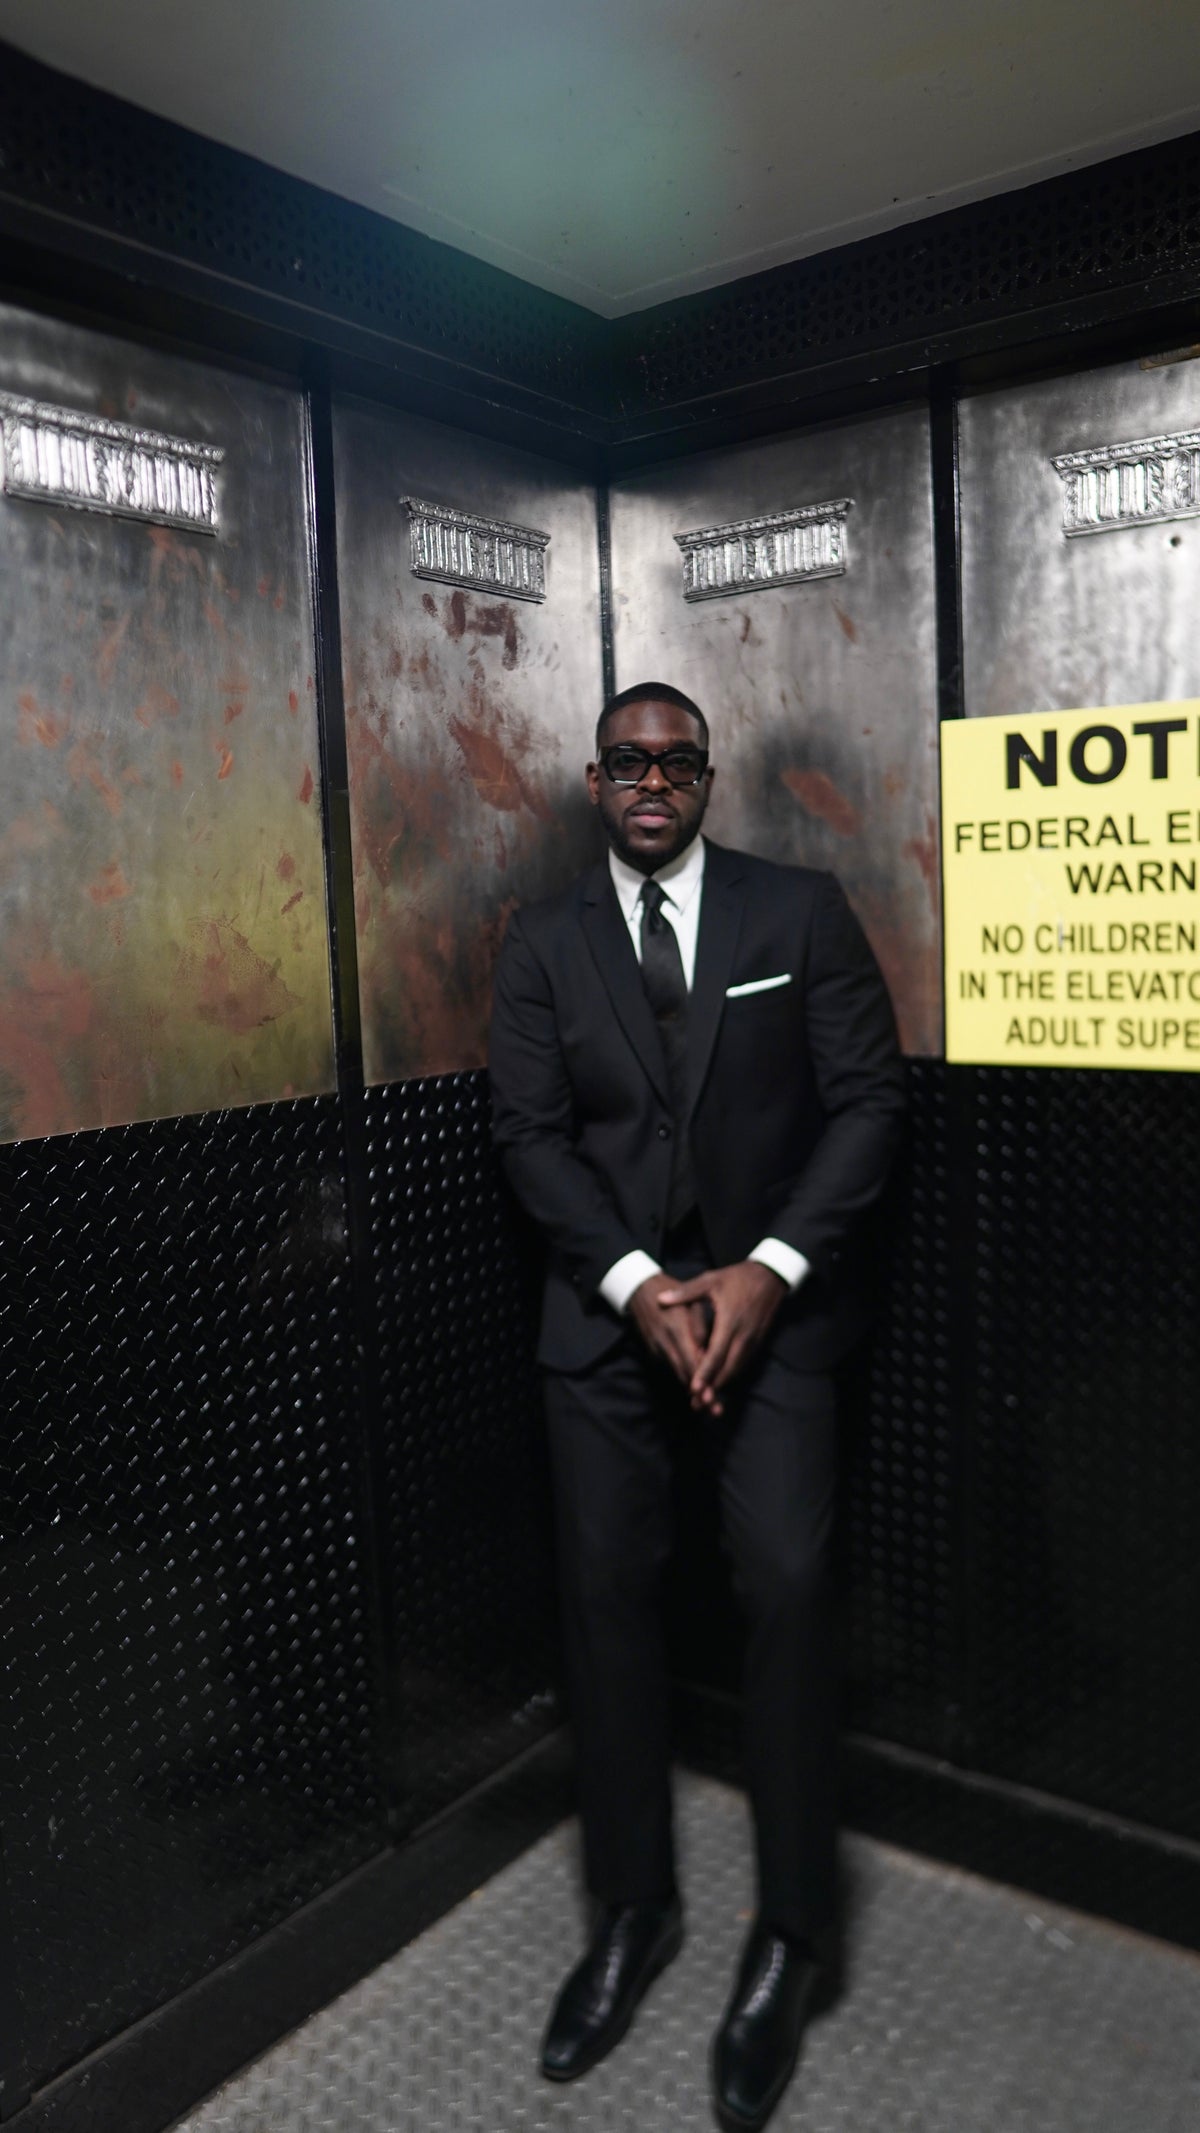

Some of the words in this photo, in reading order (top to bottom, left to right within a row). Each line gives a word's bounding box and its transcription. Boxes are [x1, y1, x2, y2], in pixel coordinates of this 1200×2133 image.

[1005, 718, 1200, 790] NOT
[955, 814, 1150, 854] FEDERAL
[1167, 810, 1200, 843] E
[1065, 860, 1197, 895] WARN
[981, 925, 1024, 954] NO
[1035, 923, 1196, 953] CHILDREN
[960, 972, 986, 999] IN
[998, 971, 1054, 1000] THE
[1006, 1017, 1104, 1047] ADULT
[1118, 1018, 1200, 1050] SUPE
